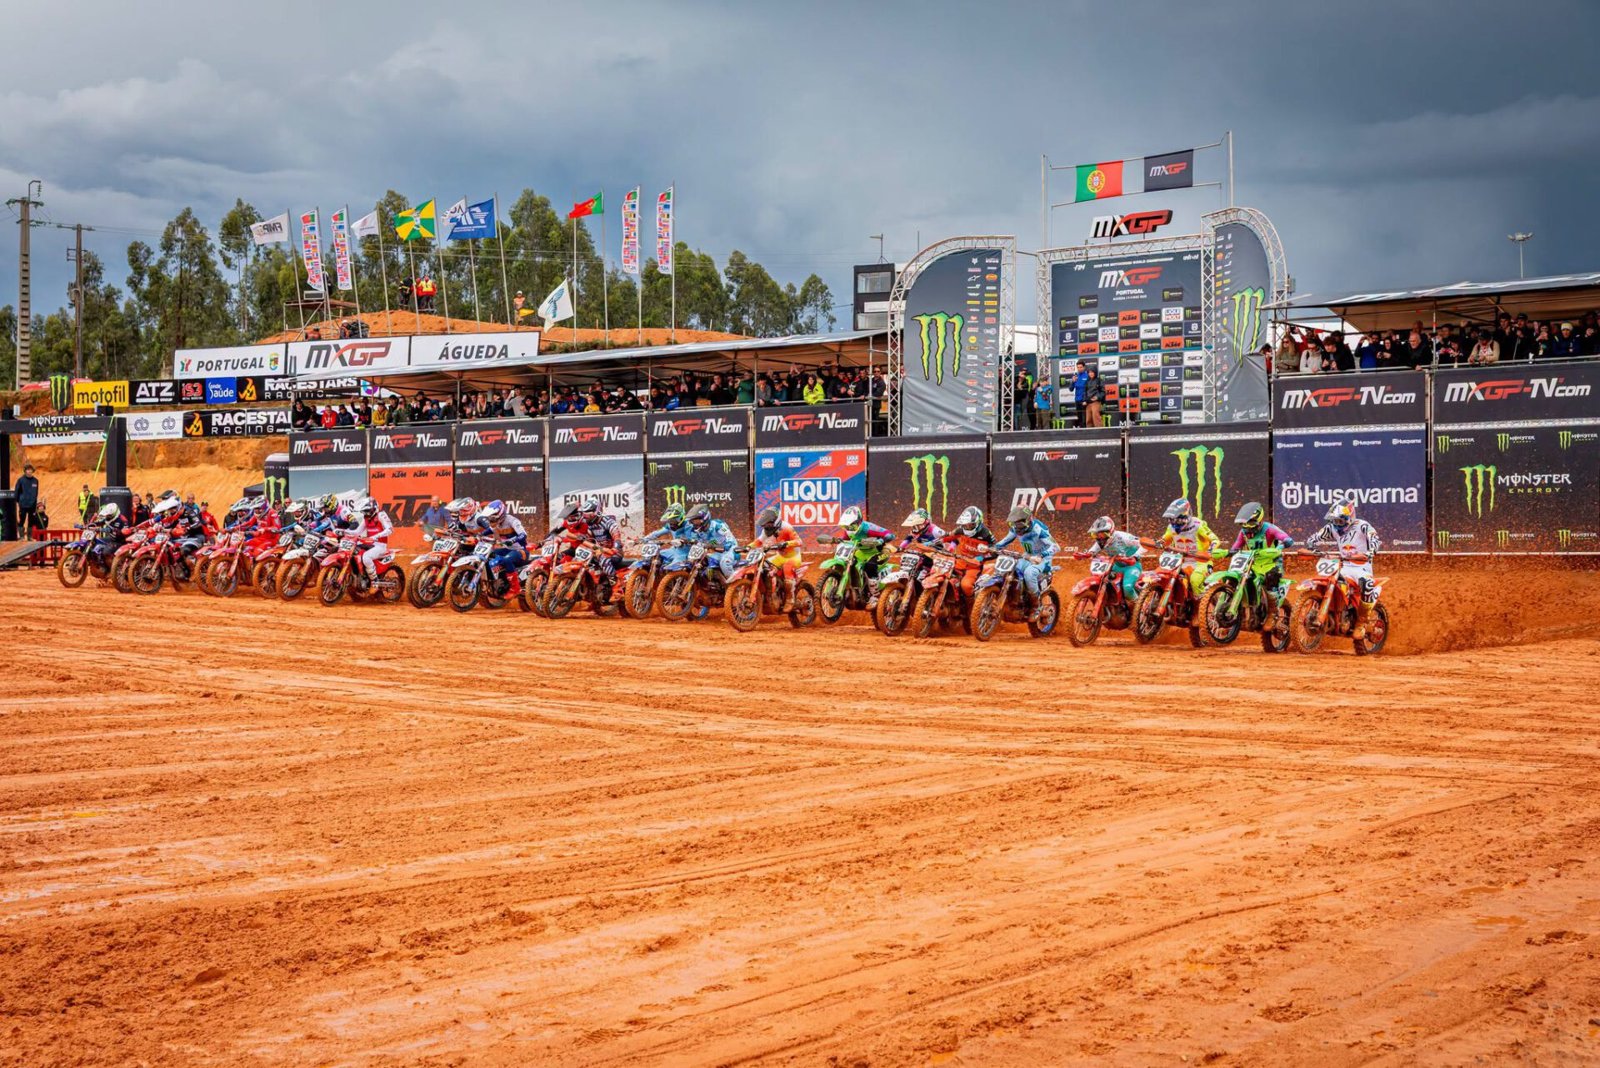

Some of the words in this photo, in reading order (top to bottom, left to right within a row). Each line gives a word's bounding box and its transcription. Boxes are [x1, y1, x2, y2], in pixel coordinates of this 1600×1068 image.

[1149, 161, 1187, 177] MXGP
[1089, 209, 1173, 238] MXGP
[1098, 266, 1164, 289] MXGP
[1115, 288, 1144, 296] PORTUGAL
[305, 341, 392, 369] MXGP
[438, 342, 509, 360] ÁGUEDA
[196, 356, 264, 372] PORTUGAL
[77, 385, 126, 404] motofil
[136, 382, 173, 398] ATZ
[29, 415, 75, 427] MONSTER
[211, 410, 292, 426] RACESTA
[211, 425, 274, 434] RACING
[1497, 472, 1573, 487] MONSTER
[686, 492, 732, 502] MONSTER
[783, 480, 838, 501] LIQUI
[1304, 484, 1418, 507] Husqvarna
[614, 493, 630, 508] US
[1010, 486, 1101, 516] MXGP
[783, 503, 840, 524] MOLY
[576, 548, 590, 560] 39
[642, 545, 657, 555] 93
[996, 557, 1013, 570] 10
[1092, 562, 1108, 572] 24
[1160, 556, 1179, 568] 84
[1231, 556, 1248, 569] 3
[1318, 562, 1335, 574] 96
